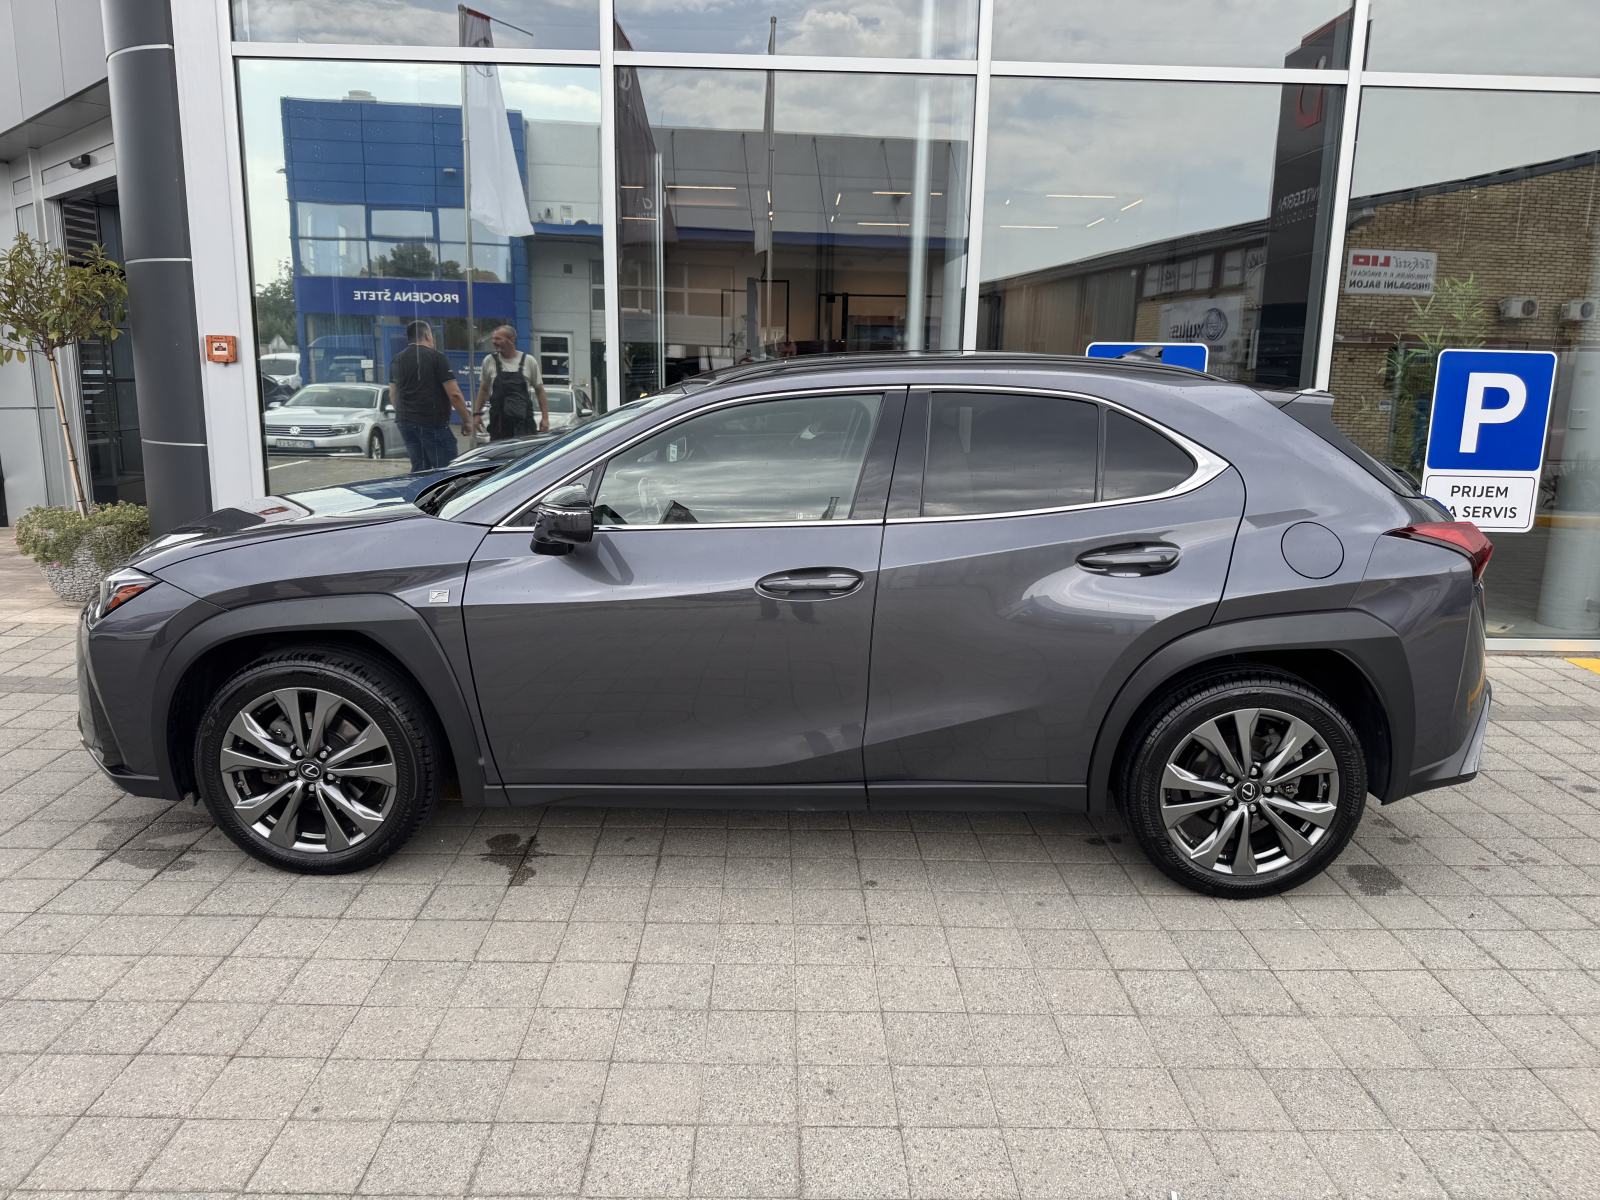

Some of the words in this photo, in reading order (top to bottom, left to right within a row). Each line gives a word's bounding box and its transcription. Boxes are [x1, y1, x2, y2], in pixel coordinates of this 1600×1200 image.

[1459, 372, 1527, 453] P
[1450, 485, 1509, 498] PRIJEM
[1462, 506, 1518, 519] SERVIS
